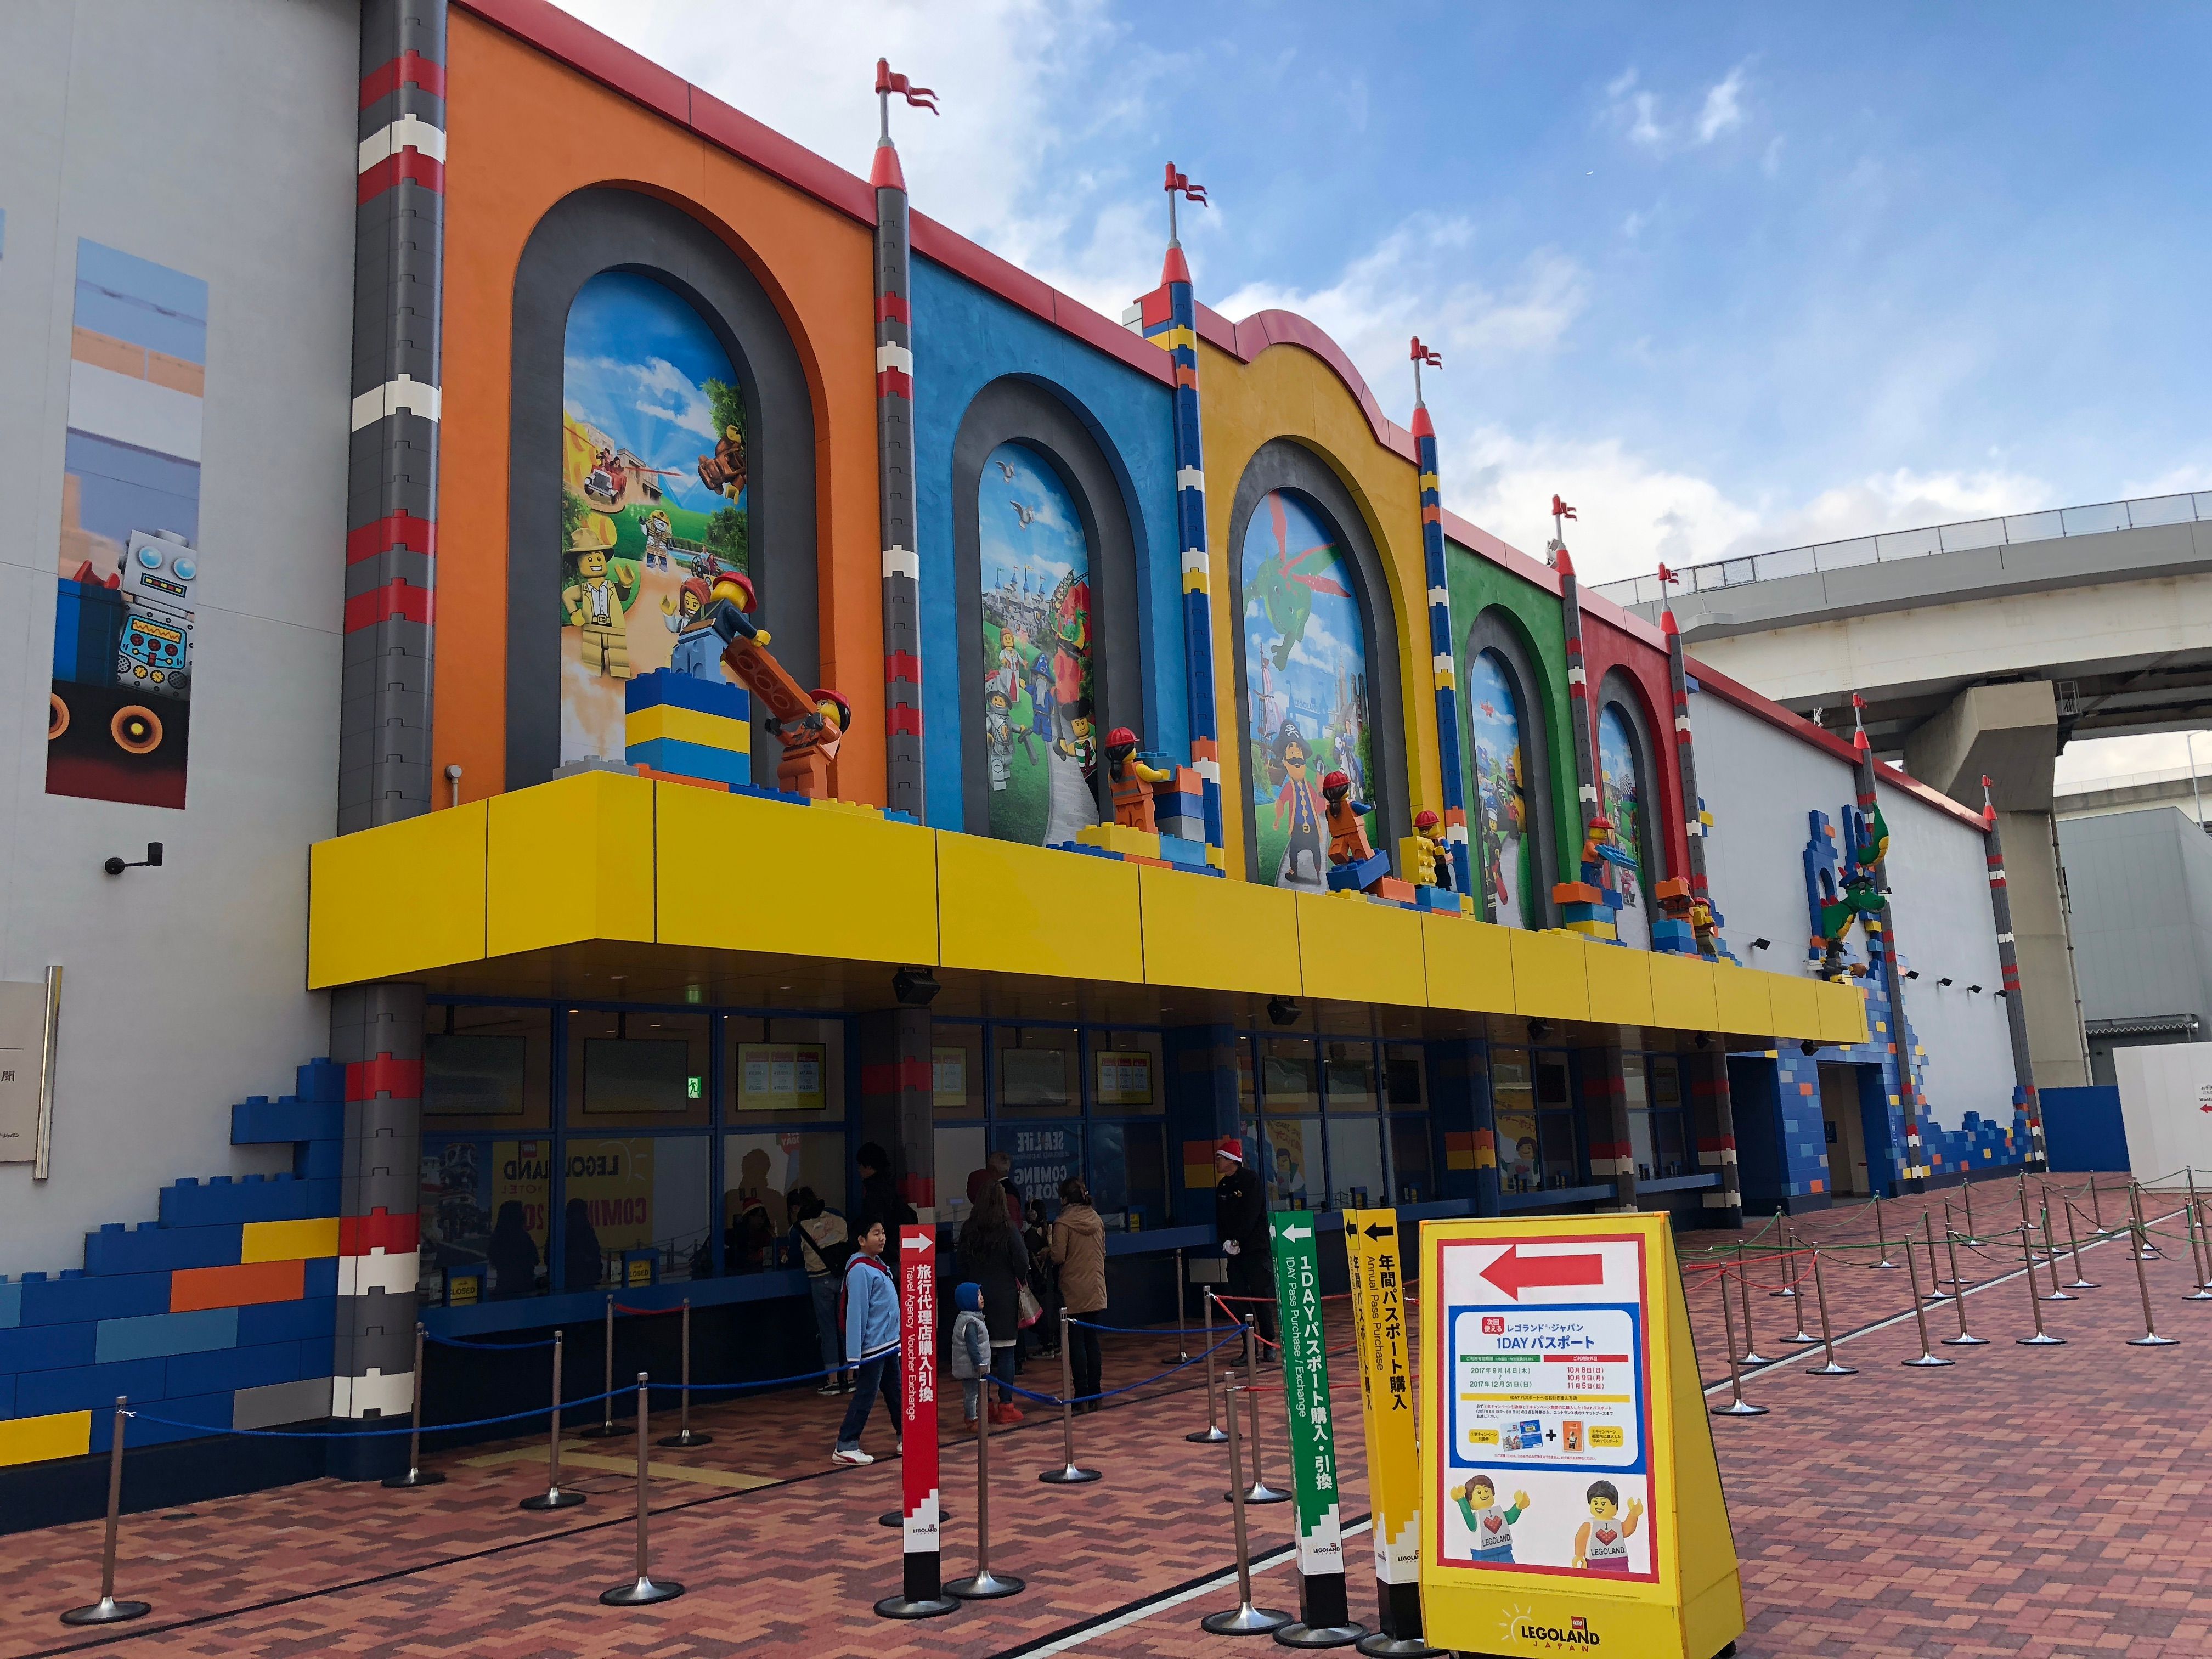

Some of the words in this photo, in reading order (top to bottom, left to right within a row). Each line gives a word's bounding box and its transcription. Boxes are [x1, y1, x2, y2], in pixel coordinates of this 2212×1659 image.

[907, 1265, 915, 1291] Travel
[1286, 1256, 1297, 1279] 1DAY
[1367, 1256, 1379, 1291] Annual
[1289, 1283, 1297, 1307] Pass
[1371, 1294, 1379, 1319] Pass
[905, 1294, 915, 1329] Agency
[917, 1264, 933, 1402] 旅行代理店購入引換
[1291, 1310, 1302, 1357] Purchase
[1373, 1322, 1384, 1370] Purchase
[1379, 1254, 1408, 1411] 年間パスポート購入
[907, 1334, 916, 1372] Voucher
[906, 1375, 916, 1421] Exchange
[1295, 1367, 1307, 1418] Exchange
[1313, 1544, 1340, 1553] LEGOLAND
[1482, 1534, 1511, 1547] LEGOLAND
[1591, 1547, 1625, 1556] LEGOLAND
[1521, 1617, 1600, 1645] LEGOLAND
[1533, 1640, 1589, 1652] JAPAN
